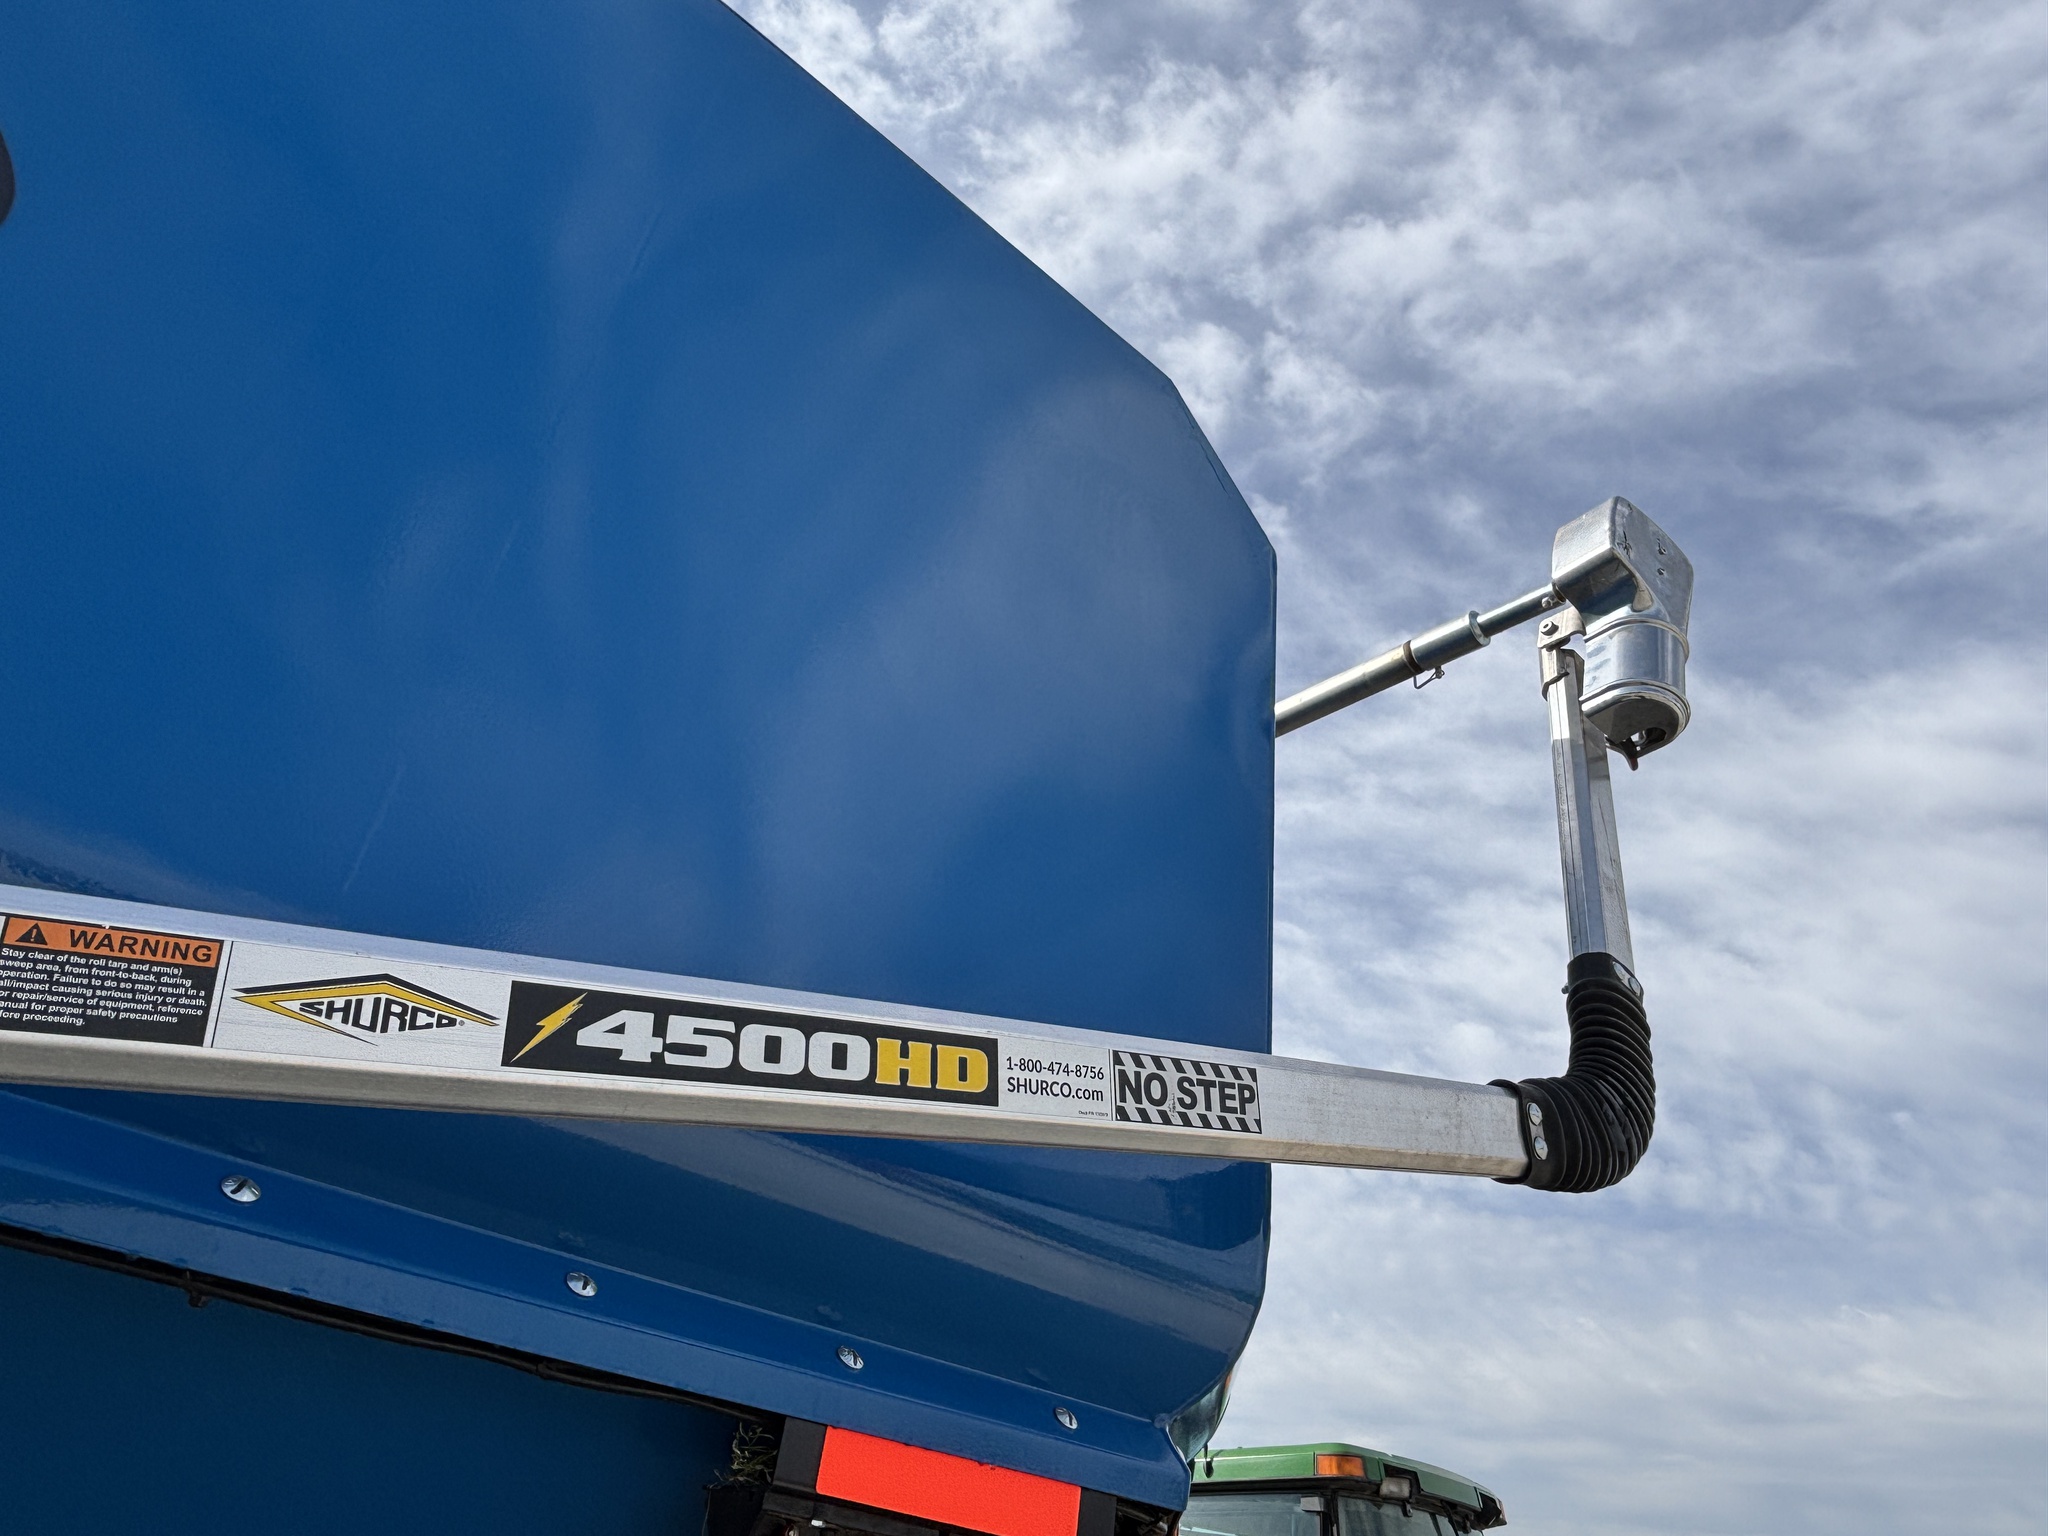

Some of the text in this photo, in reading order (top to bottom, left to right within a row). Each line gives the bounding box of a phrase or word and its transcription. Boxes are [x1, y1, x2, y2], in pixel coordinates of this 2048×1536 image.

[69, 928, 212, 963] WARNING
[2, 947, 183, 976] Stay clear of the roll tarp and arm(s)
[36, 962, 62, 973] area,
[64, 965, 89, 975] from
[160, 976, 193, 988] during
[53, 973, 89, 985] Failure
[91, 978, 102, 986] to
[104, 979, 118, 987] do
[119, 981, 133, 989] so
[134, 983, 156, 993] may
[158, 985, 186, 995] result
[187, 988, 197, 996] in
[12, 990, 84, 1004] repair/service
[86, 997, 98, 1006] of
[99, 1000, 155, 1013] equipment,
[157, 1005, 204, 1016] reference
[51, 985, 93, 997] causing
[95, 989, 133, 999] serious
[135, 991, 164, 1004] injury
[165, 996, 177, 1004] or
[178, 996, 208, 1007] death.
[22, 1012, 86, 1026] proceeding.
[30, 1002, 47, 1010] for
[48, 1005, 85, 1015] proper
[86, 1008, 118, 1019] safety
[119, 1011, 179, 1023] precautions
[299, 996, 457, 1034] SHURCO
[576, 1009, 988, 1093] 4500HD
[1006, 1056, 1105, 1080] 1-800-474-8756
[1007, 1076, 1104, 1102] SHURCO.com
[1117, 1068, 1168, 1107] NO
[1176, 1075, 1256, 1115] STEP
